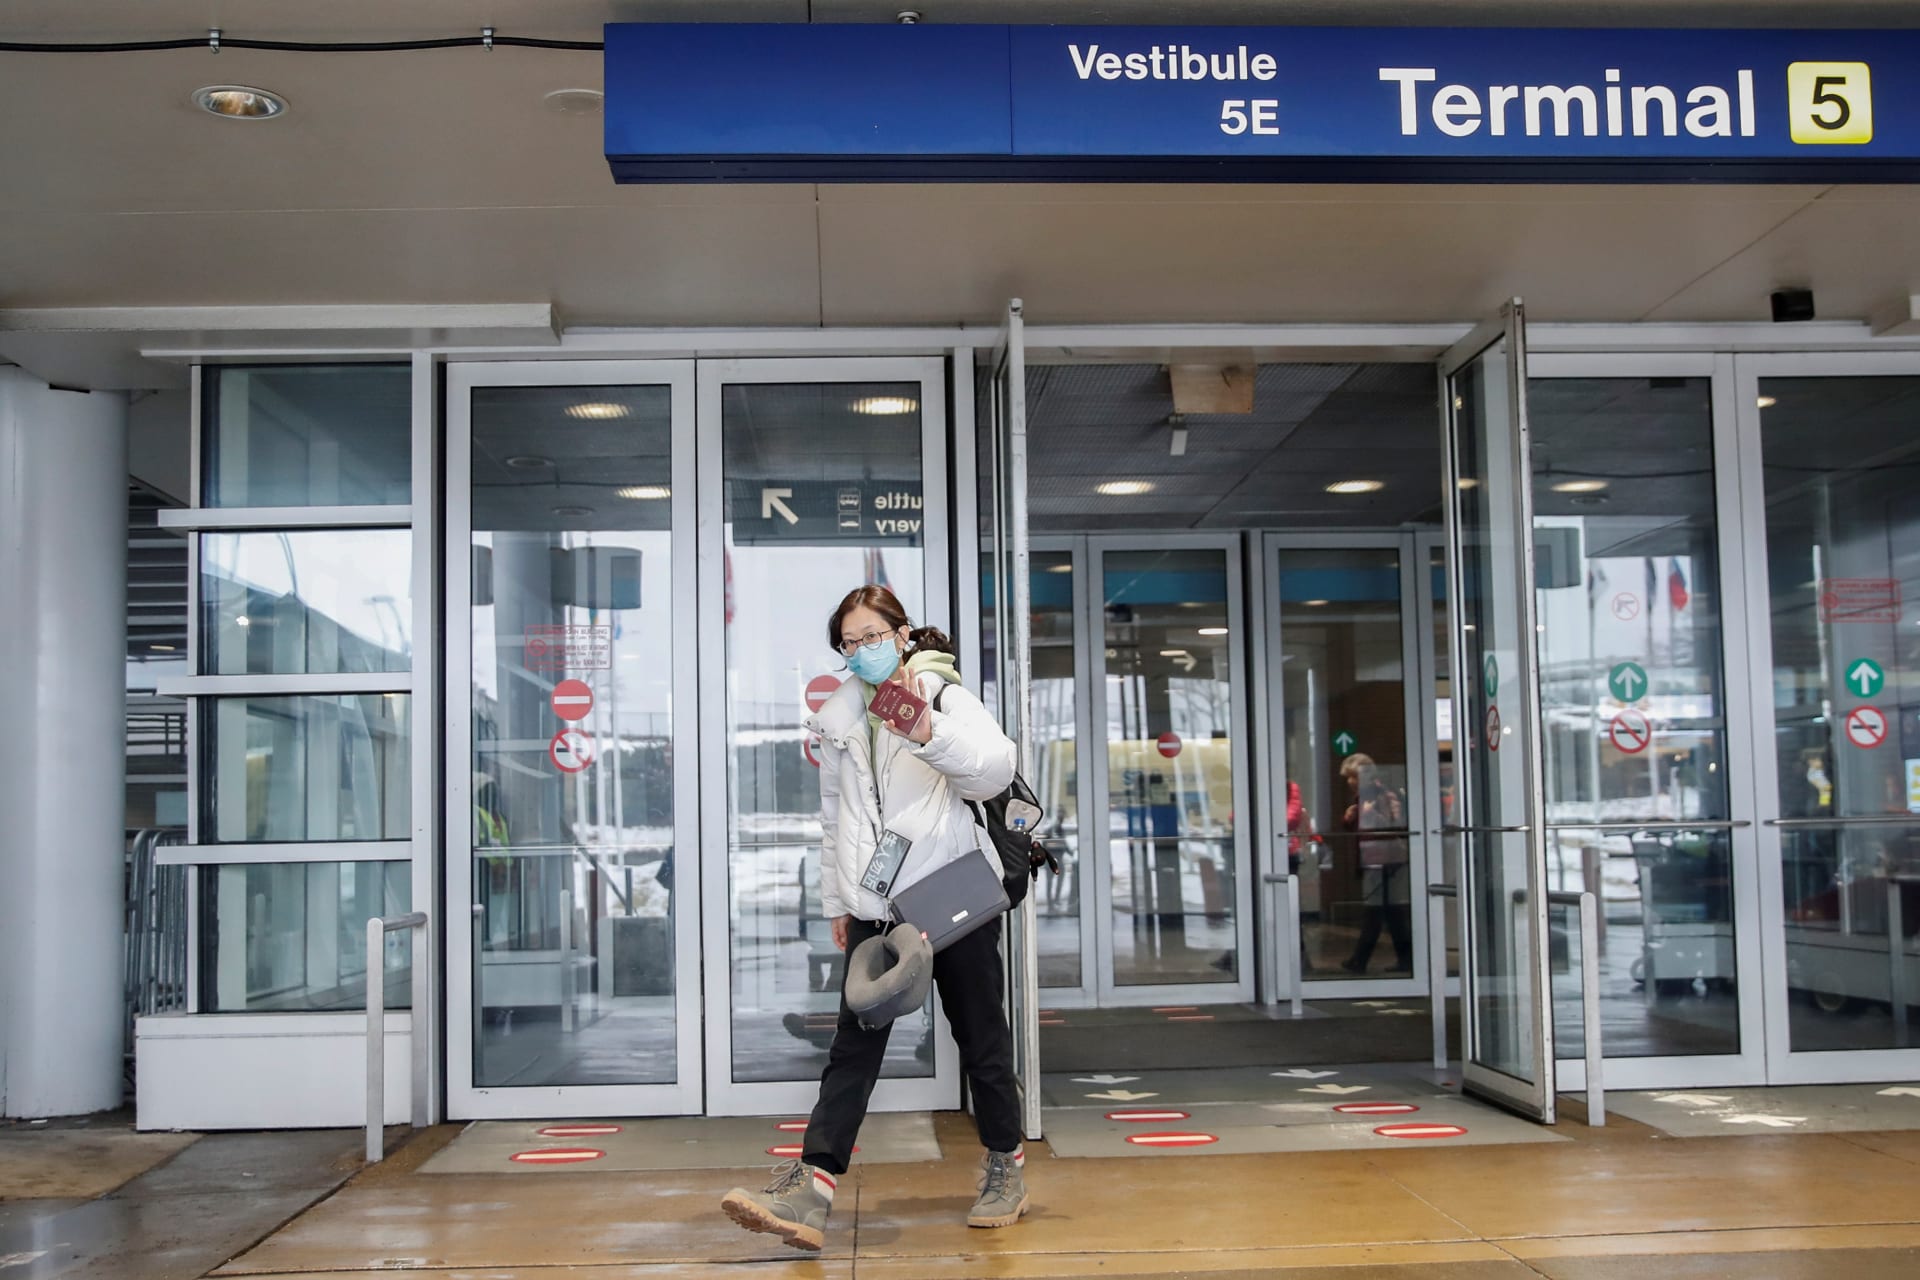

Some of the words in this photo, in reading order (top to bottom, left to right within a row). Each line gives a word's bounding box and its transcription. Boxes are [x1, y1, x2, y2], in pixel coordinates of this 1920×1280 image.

[1068, 44, 1278, 82] Vestibule
[1220, 99, 1280, 136] 5E
[1378, 67, 1756, 138] Terminal
[1811, 76, 1851, 130] 5
[863, 831, 897, 890] 生人勿近
